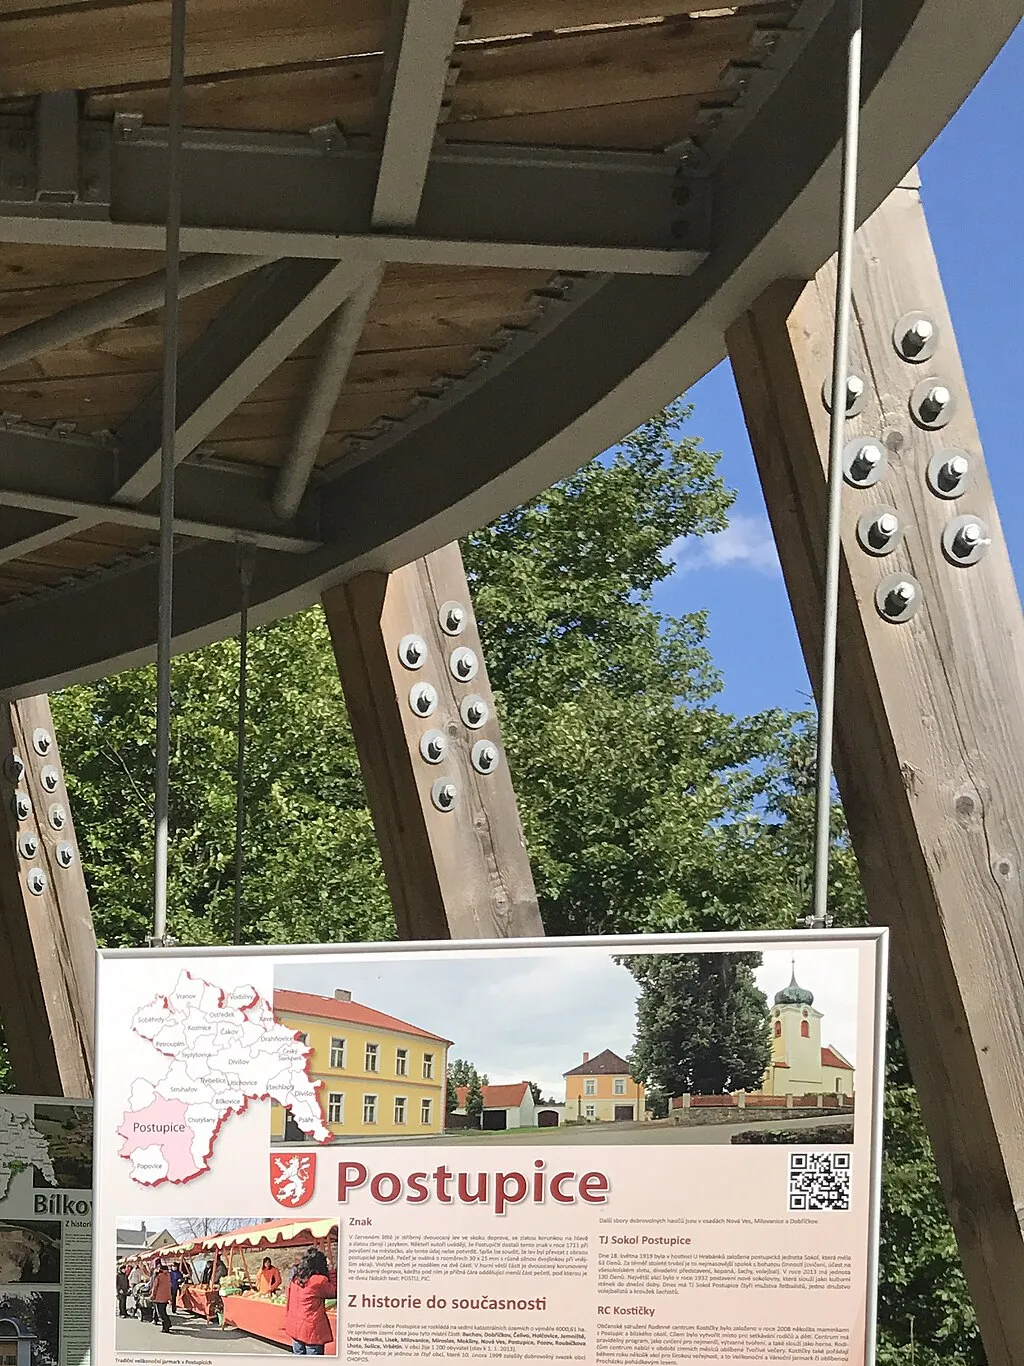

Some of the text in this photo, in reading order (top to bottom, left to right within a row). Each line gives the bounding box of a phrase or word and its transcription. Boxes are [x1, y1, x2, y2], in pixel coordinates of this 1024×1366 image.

[134, 1122, 185, 1134] Postupice
[338, 1160, 608, 1214] Postupice
[349, 1217, 372, 1226] Znak
[598, 1236, 691, 1246] TJ Sokol Postupice
[348, 1294, 546, 1310] Z historie do současnosti
[598, 1306, 655, 1317] RC Kostičky
